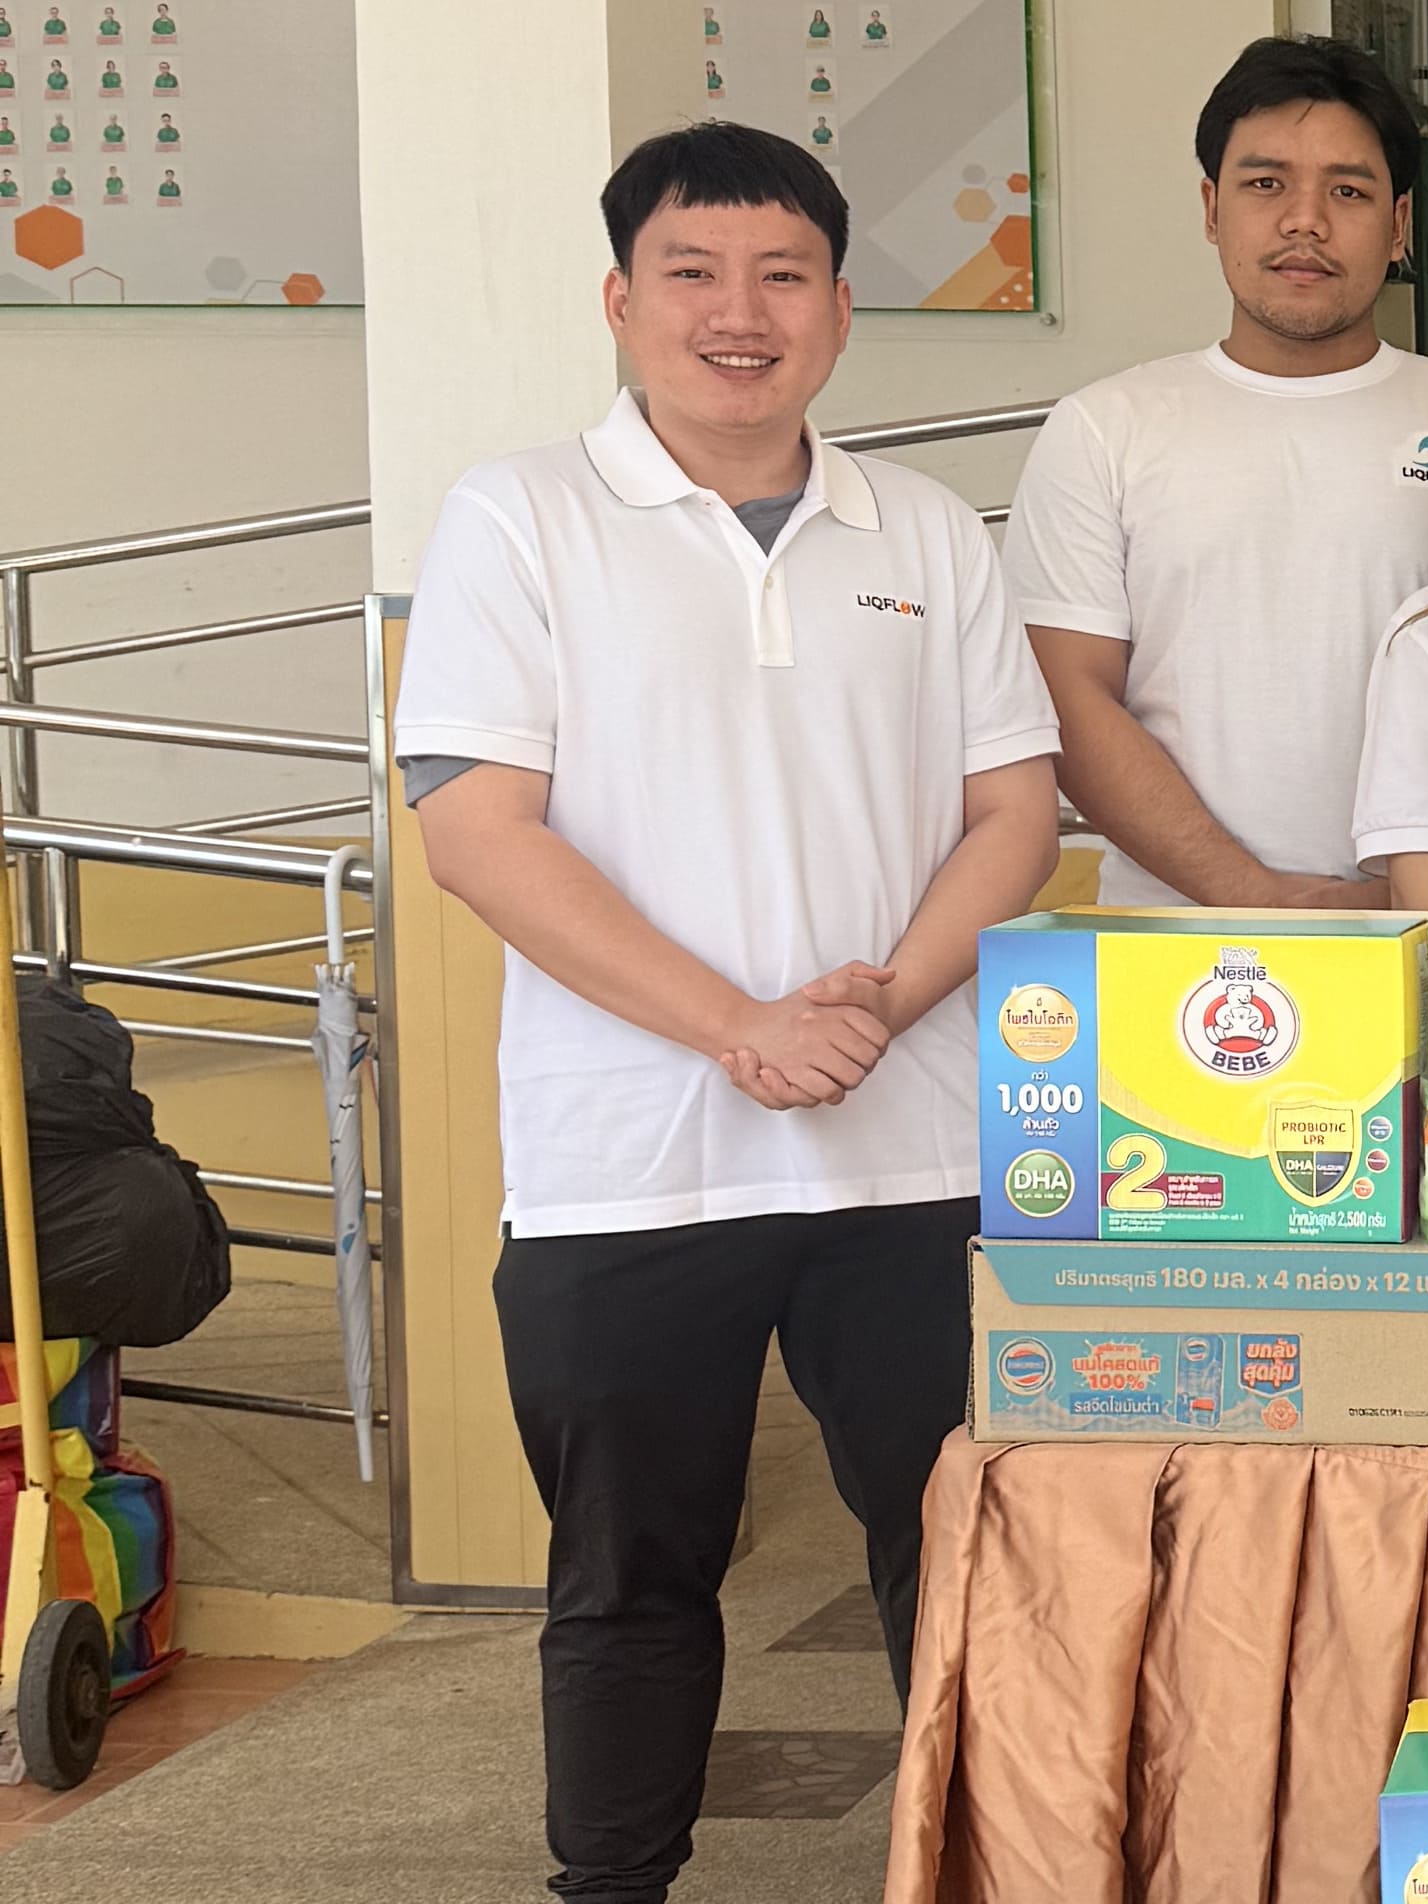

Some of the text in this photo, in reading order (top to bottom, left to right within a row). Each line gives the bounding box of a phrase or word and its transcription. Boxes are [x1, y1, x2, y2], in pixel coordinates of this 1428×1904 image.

[857, 594, 925, 618] LIQFLOW
[1212, 1050, 1271, 1072] BEBE
[997, 1083, 1084, 1115] 1,000
[1281, 1121, 1347, 1134] PROBIOTIC
[1303, 1134, 1325, 1146] LPR
[1013, 1168, 1068, 1191] DHA
[1338, 1212, 1367, 1229] 2,500
[1055, 1269, 1158, 1292] ปริมาตรสุทธิ
[1160, 1267, 1207, 1289] 180
[1213, 1271, 1251, 1290] มล.
[1295, 1266, 1361, 1292] กล่อง
[1384, 1272, 1410, 1292] 12
[1090, 1374, 1147, 1391] 100%
